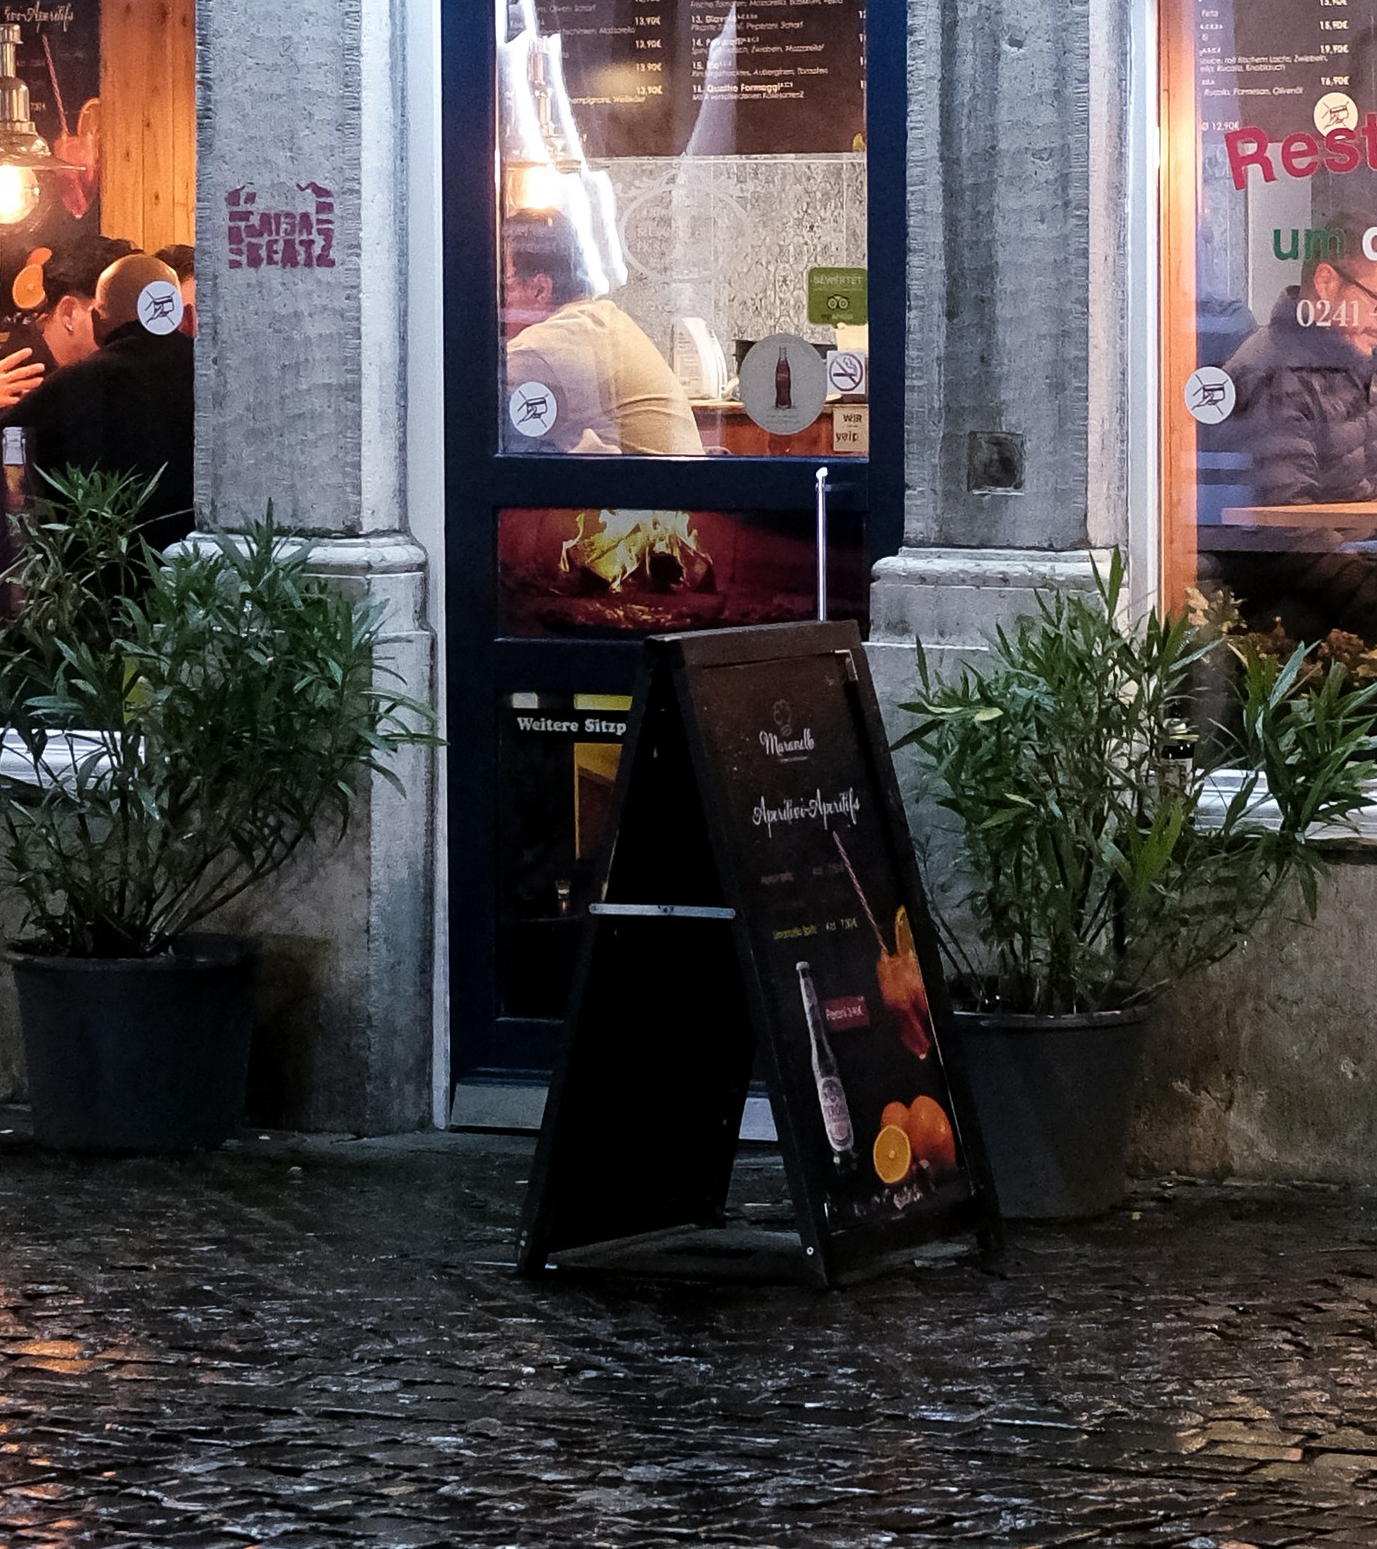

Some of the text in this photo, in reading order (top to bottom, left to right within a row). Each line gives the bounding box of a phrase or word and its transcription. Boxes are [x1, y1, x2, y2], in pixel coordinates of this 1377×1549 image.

[1272, 226, 1346, 262] um
[1296, 299, 1360, 328] 0241
[842, 414, 863, 424] WIR
[516, 716, 579, 733] Weitere
[758, 727, 816, 756] Maranello
